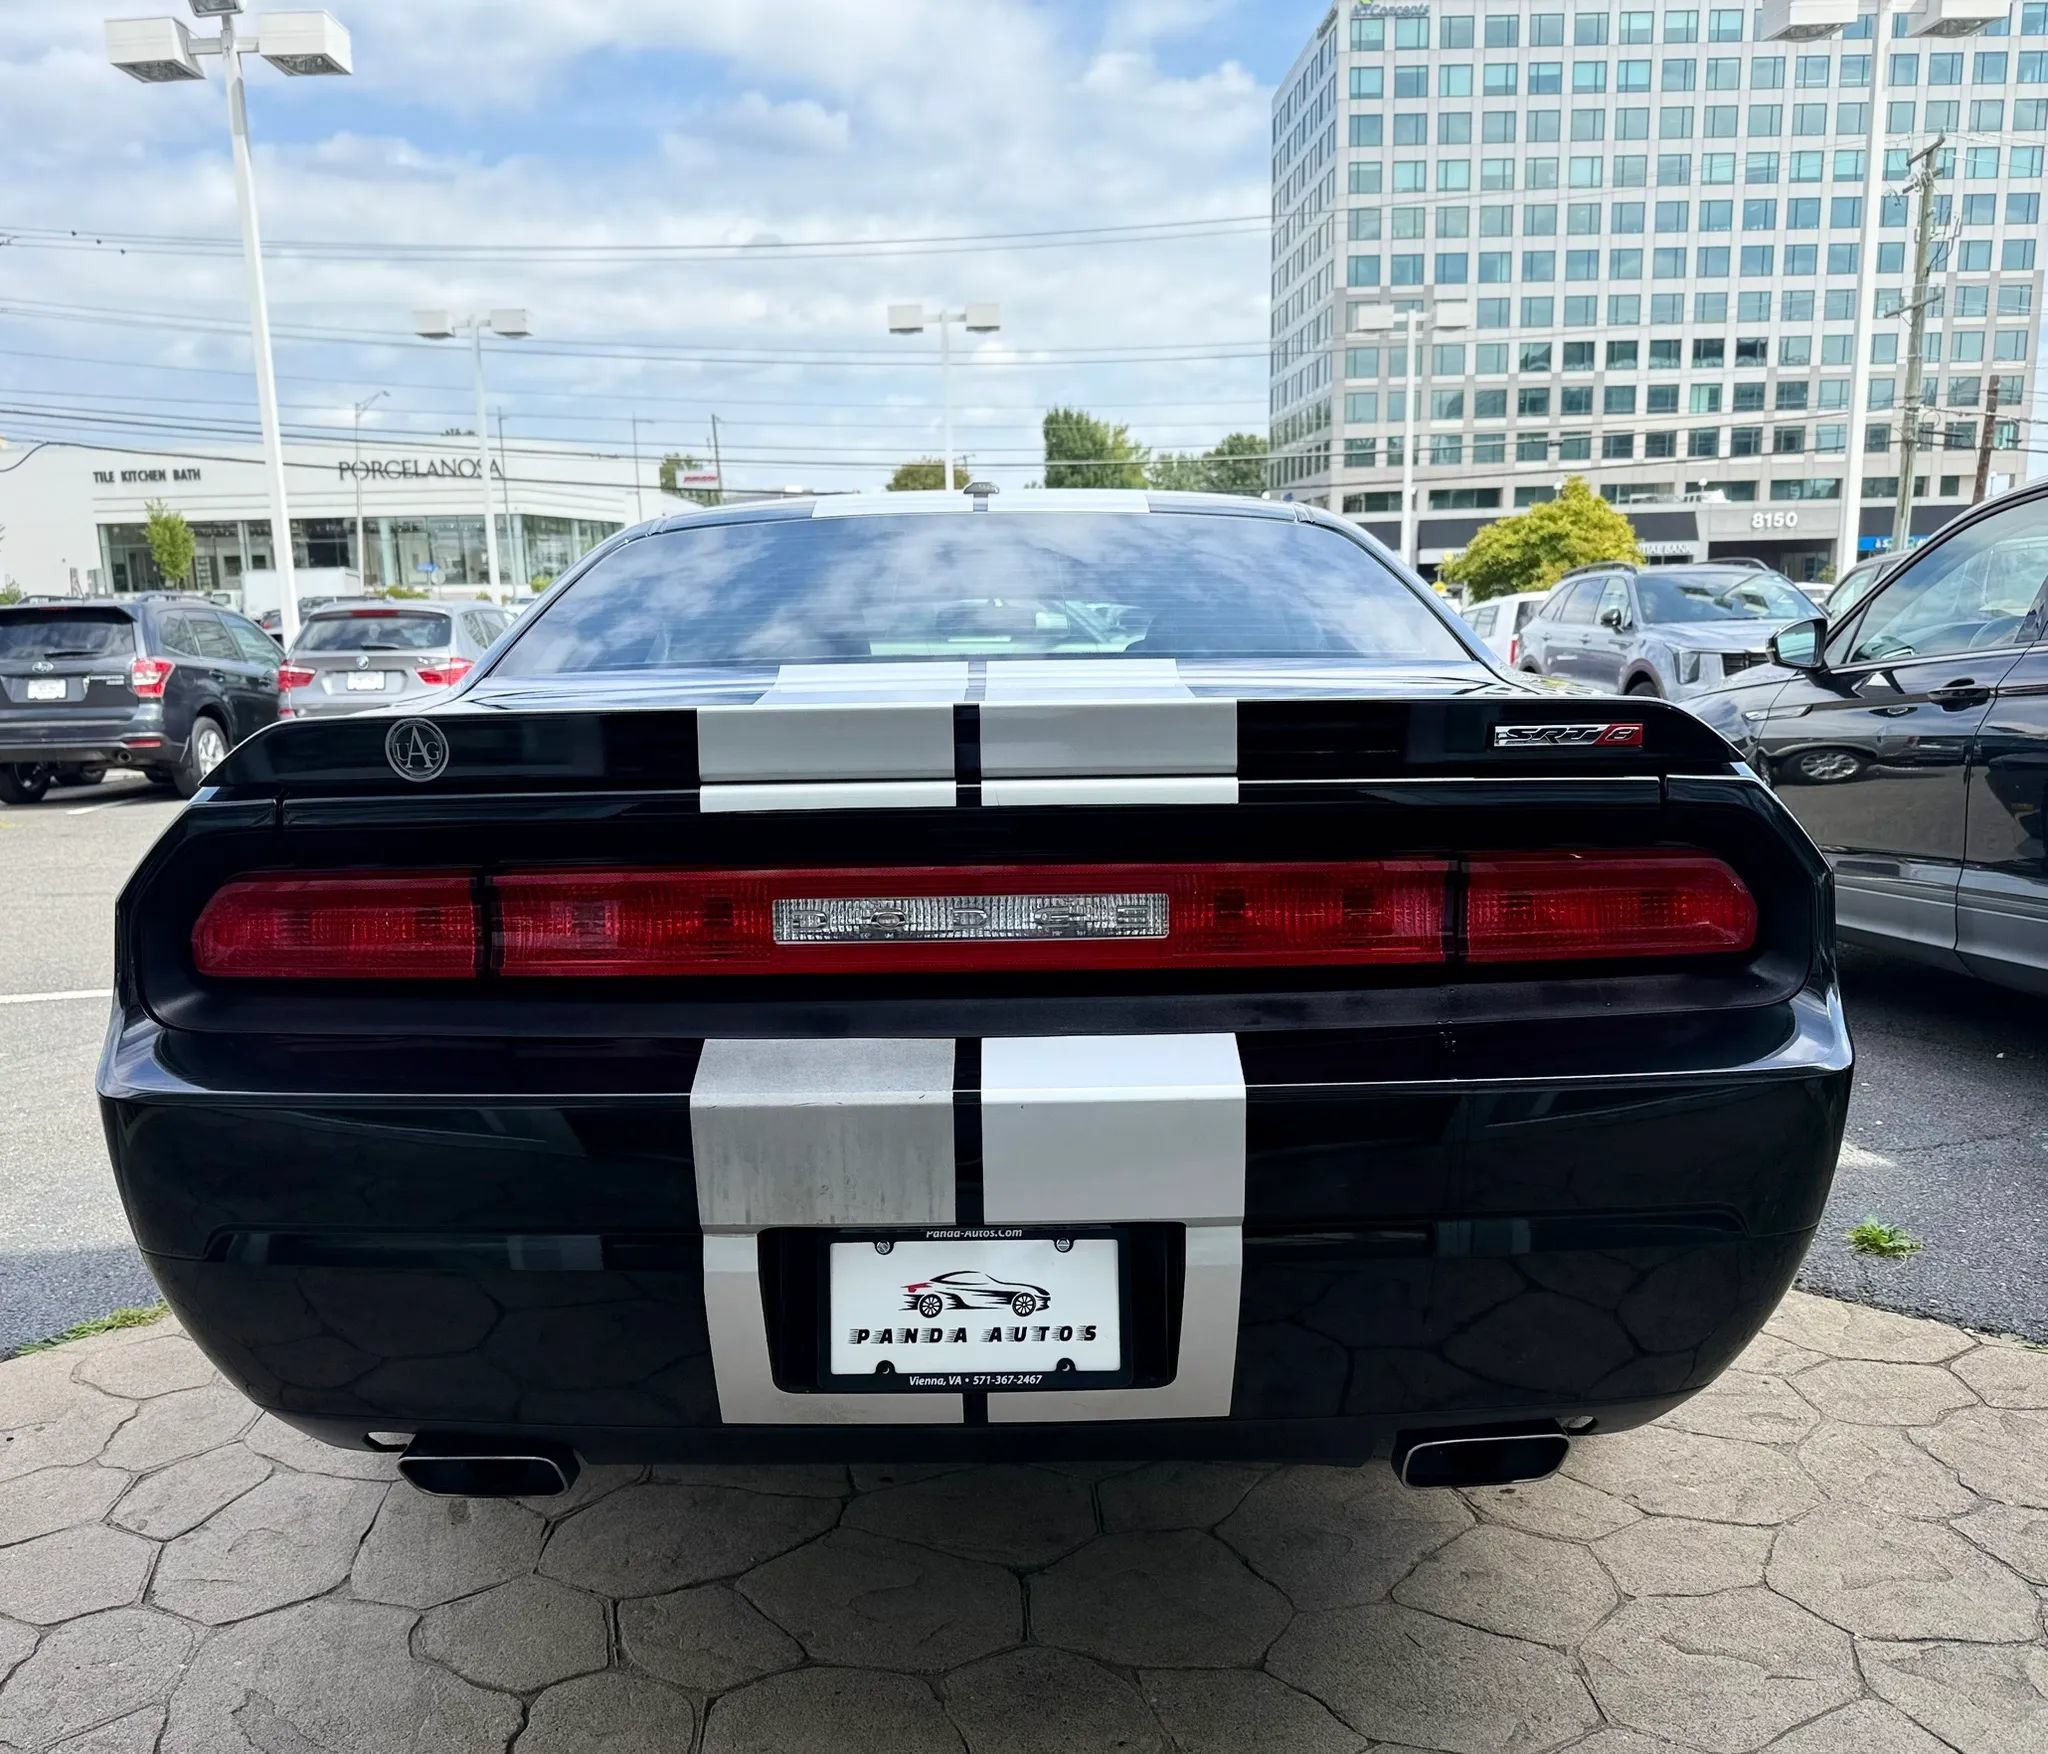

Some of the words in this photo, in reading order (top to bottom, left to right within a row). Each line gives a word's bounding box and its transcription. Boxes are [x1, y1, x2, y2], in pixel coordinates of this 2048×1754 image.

[93, 471, 115, 483] TILE
[121, 469, 167, 482] KITCHEN
[173, 468, 201, 481] BATH
[1751, 511, 1798, 529] 8150
[926, 1228, 1023, 1239] Panda-Autos.Com
[848, 1327, 968, 1344] PANDA
[979, 1325, 1097, 1343] AUTOS
[909, 1376, 946, 1386] Vienna,
[948, 1375, 962, 1385] VA
[973, 1374, 1043, 1385] 571-367-2467
